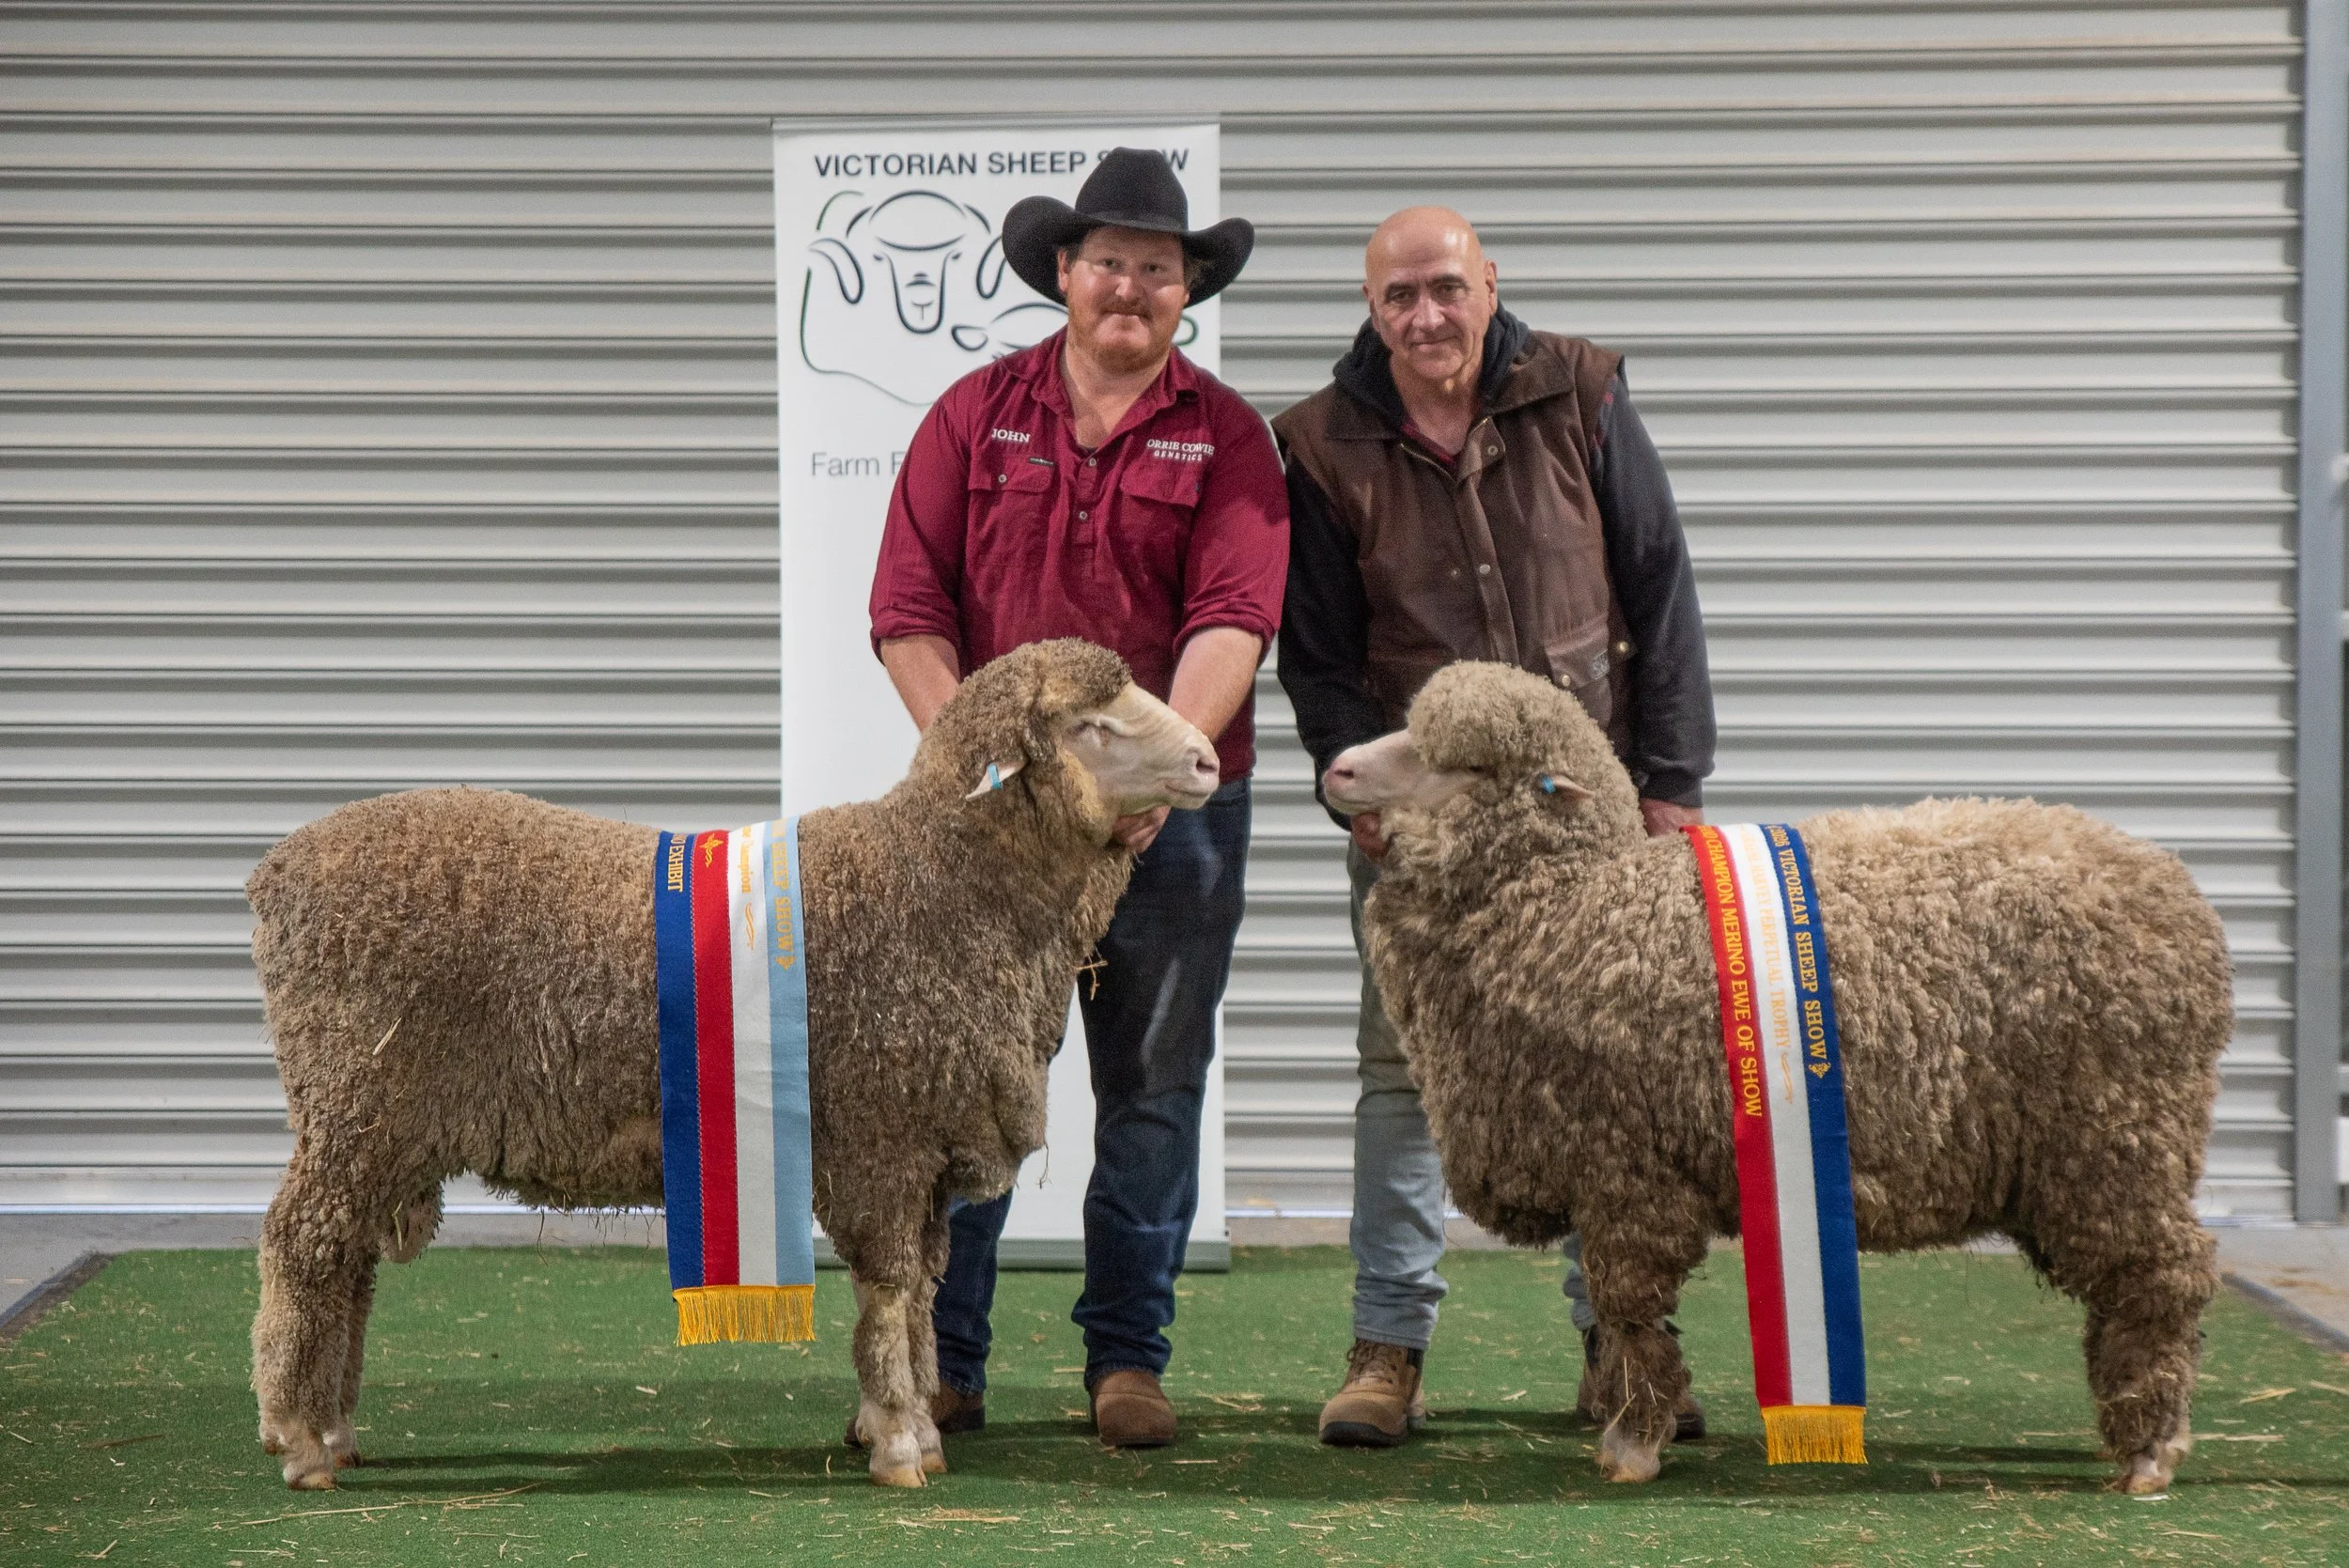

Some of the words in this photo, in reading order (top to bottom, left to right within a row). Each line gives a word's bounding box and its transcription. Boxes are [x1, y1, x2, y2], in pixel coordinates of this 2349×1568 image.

[815, 152, 977, 177] VICTORIAN
[988, 150, 1087, 175] SHEEP
[811, 452, 880, 477] Farm
[991, 428, 1032, 444] JOHN
[1146, 439, 1182, 452] ORRIE
[1182, 442, 1215, 457] COWIE
[1154, 451, 1204, 462] GENETICS
[667, 846, 685, 893] EXHIBIT
[1705, 839, 1736, 904] CHAMPION
[1779, 847, 1810, 925] VICTORIAN
[773, 896, 794, 953] SHOW
[1720, 908, 1747, 975] MERINO
[1759, 908, 1783, 986] PERPETUAL
[1795, 931, 1819, 993] SHEEP
[1730, 980, 1751, 1021] EWE
[1769, 988, 1792, 1048] TROPHY
[1736, 1024, 1755, 1052] OF
[1803, 1000, 1828, 1060] SHOW
[1740, 1057, 1763, 1118] SHOW
